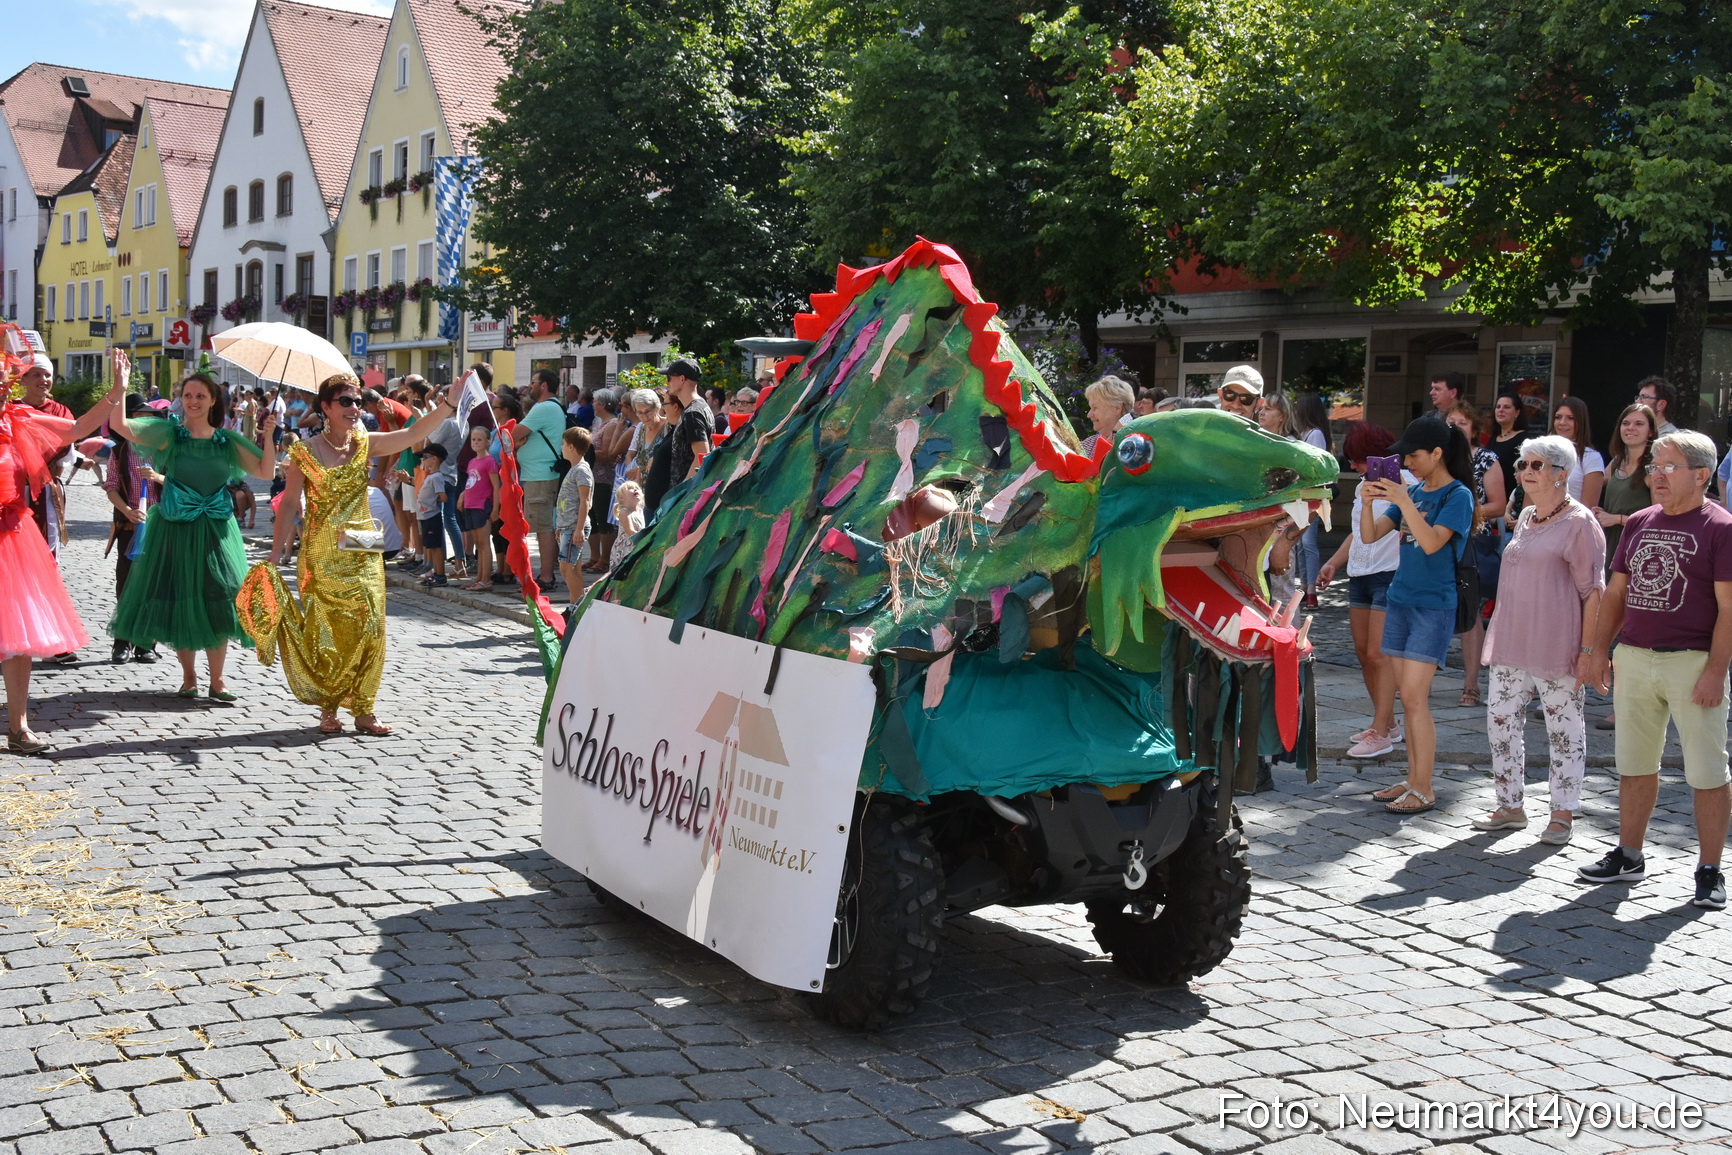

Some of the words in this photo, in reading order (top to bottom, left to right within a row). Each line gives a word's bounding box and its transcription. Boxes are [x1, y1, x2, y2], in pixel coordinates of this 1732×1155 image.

[70, 260, 88, 277] HOTEL
[68, 337, 93, 348] Restaurant
[354, 335, 364, 352] P
[1628, 597, 1670, 609] RENEGADES
[552, 702, 712, 845] Schloss-Spiele
[729, 826, 786, 866] Neumarkt
[787, 851, 818, 875] e.V.
